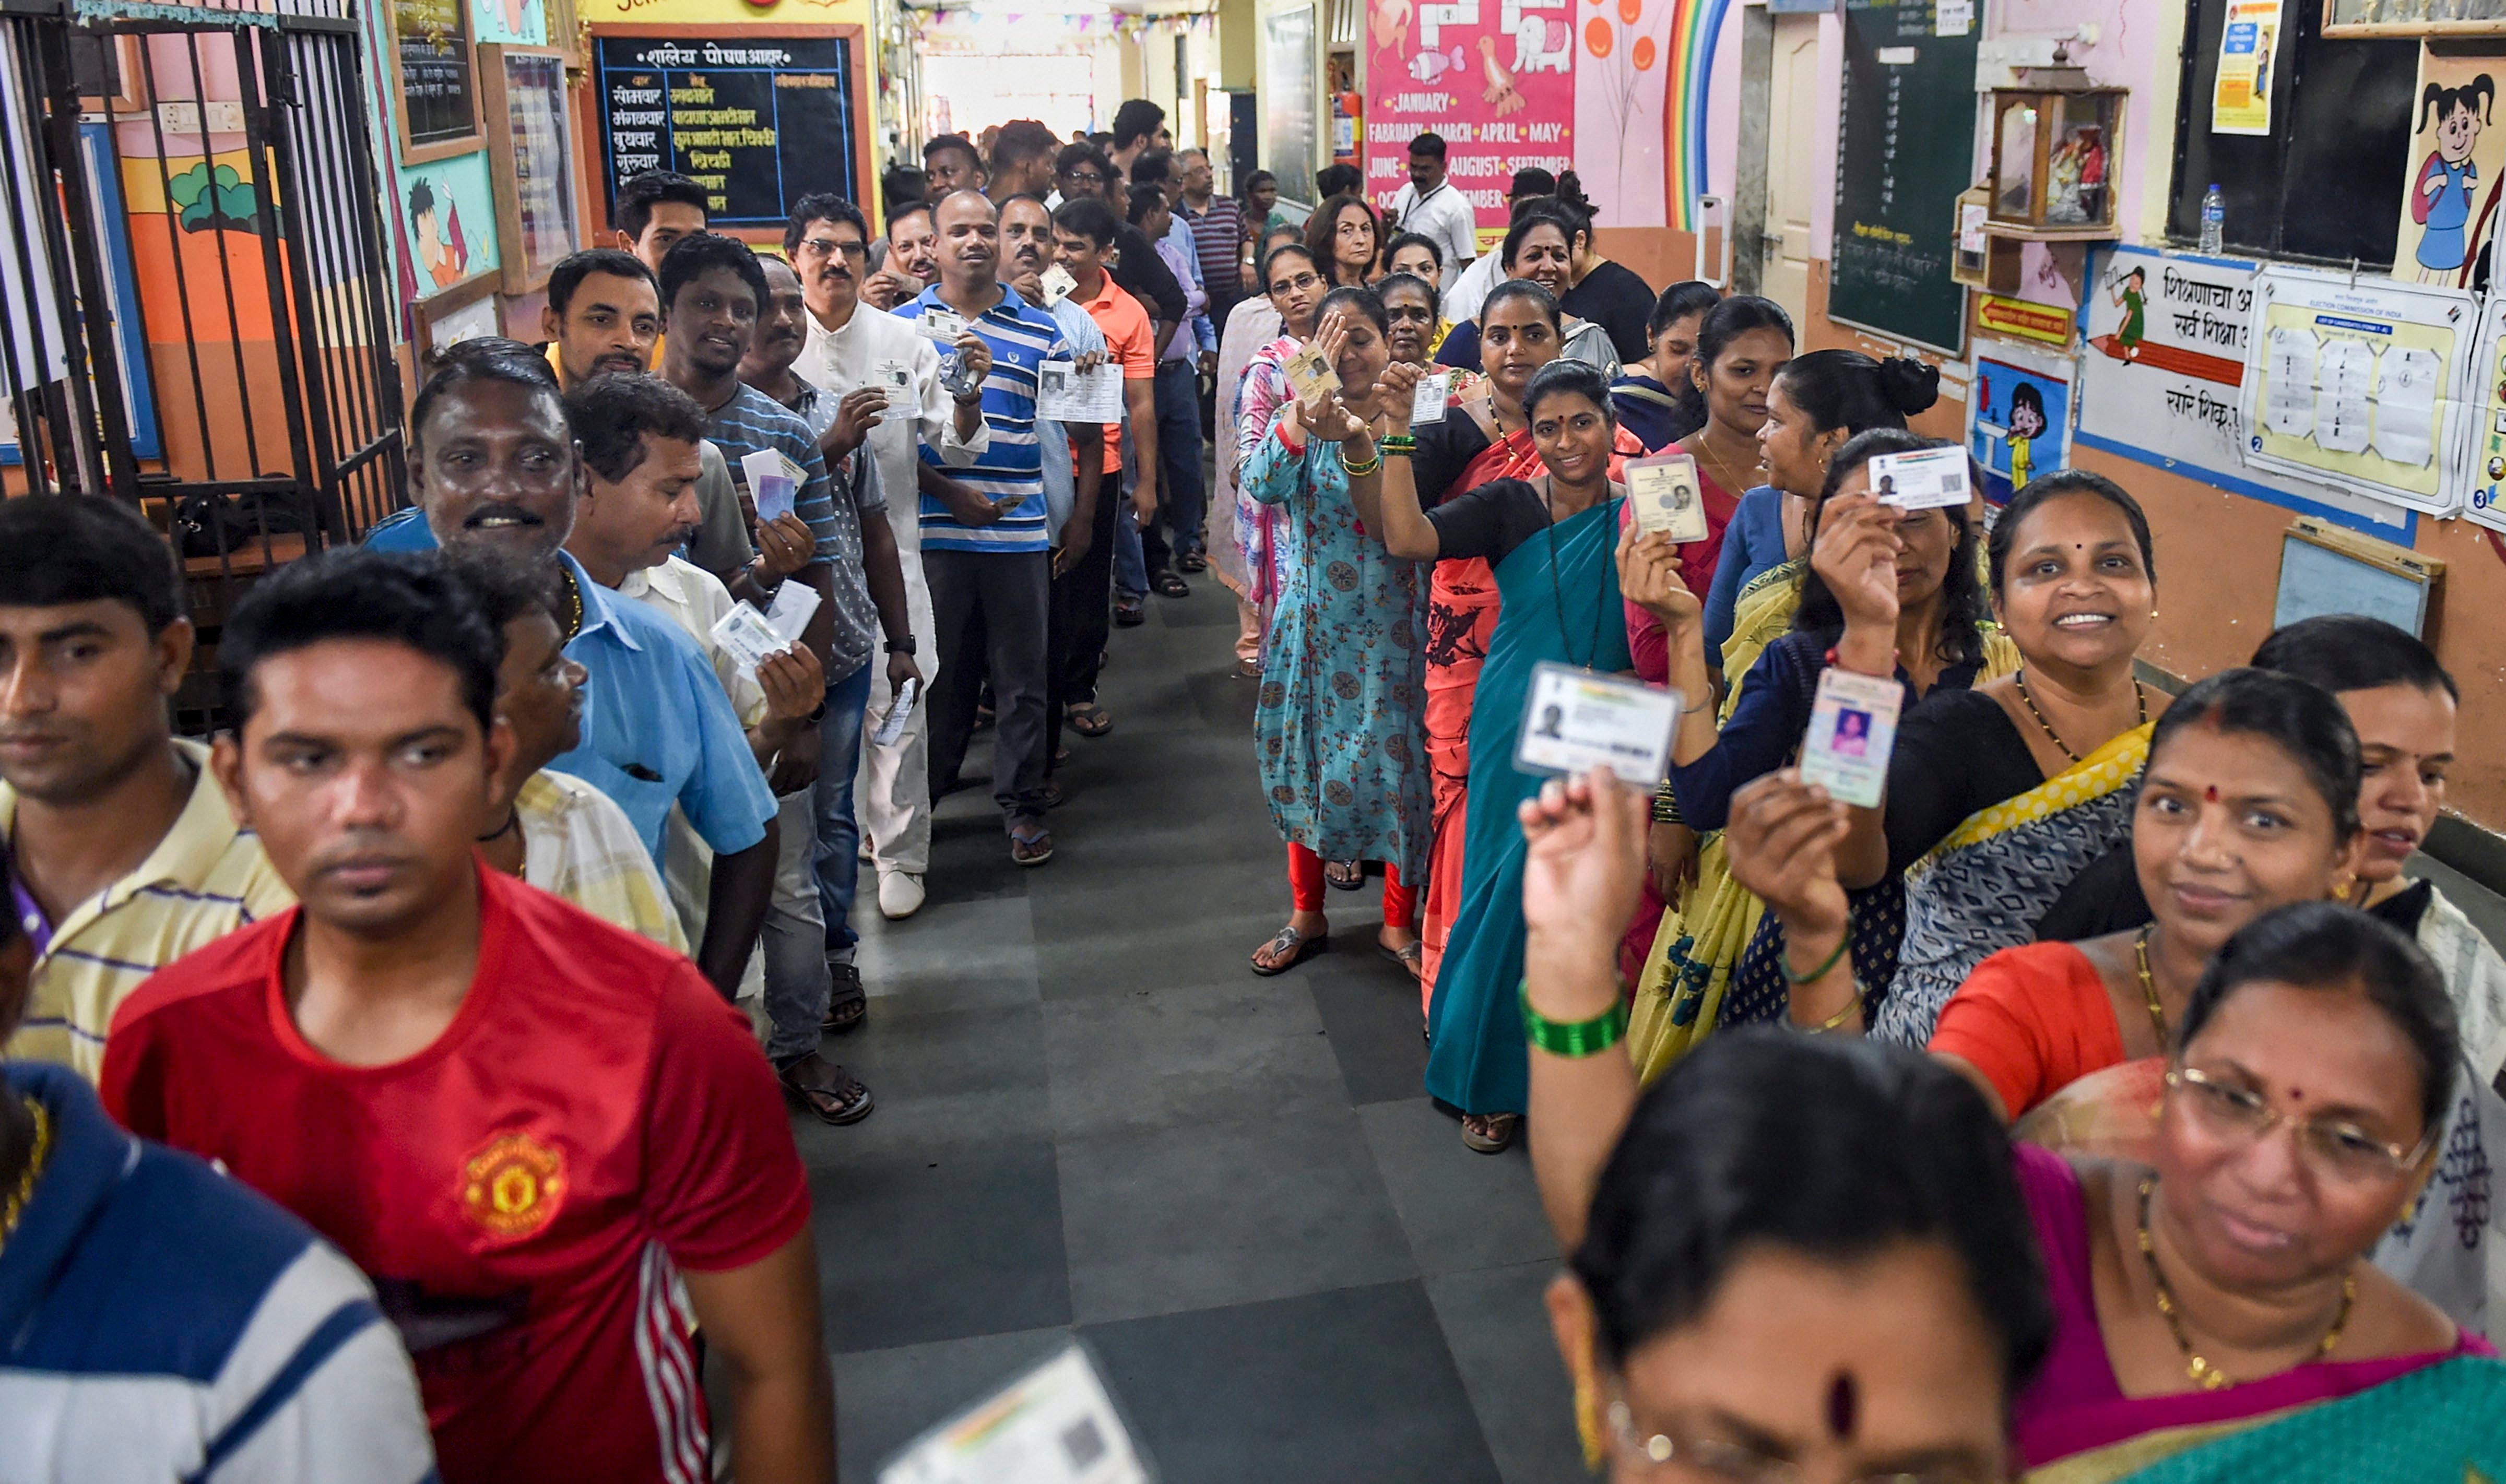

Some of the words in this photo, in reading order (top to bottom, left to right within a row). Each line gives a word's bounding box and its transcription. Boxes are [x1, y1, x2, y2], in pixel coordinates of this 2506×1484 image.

[647, 42, 698, 68] शालेय
[612, 85, 662, 105] सोमवार
[1394, 92, 1449, 113] JANUARY
[612, 108, 665, 127] मंगळवार
[1368, 123, 1423, 143] FABRUARY
[1431, 123, 1472, 143] MARCH
[1480, 123, 1520, 143] APRIL
[1529, 123, 1563, 143] MAY
[1368, 157, 1399, 178] JUNE
[1448, 156, 1500, 177] AUGUST
[2310, 300, 2335, 309] ELECTION
[2337, 304, 2374, 314] COMMISSION
[2173, 310, 2200, 338] सर्व
[2203, 312, 2238, 347] शिक्षा
